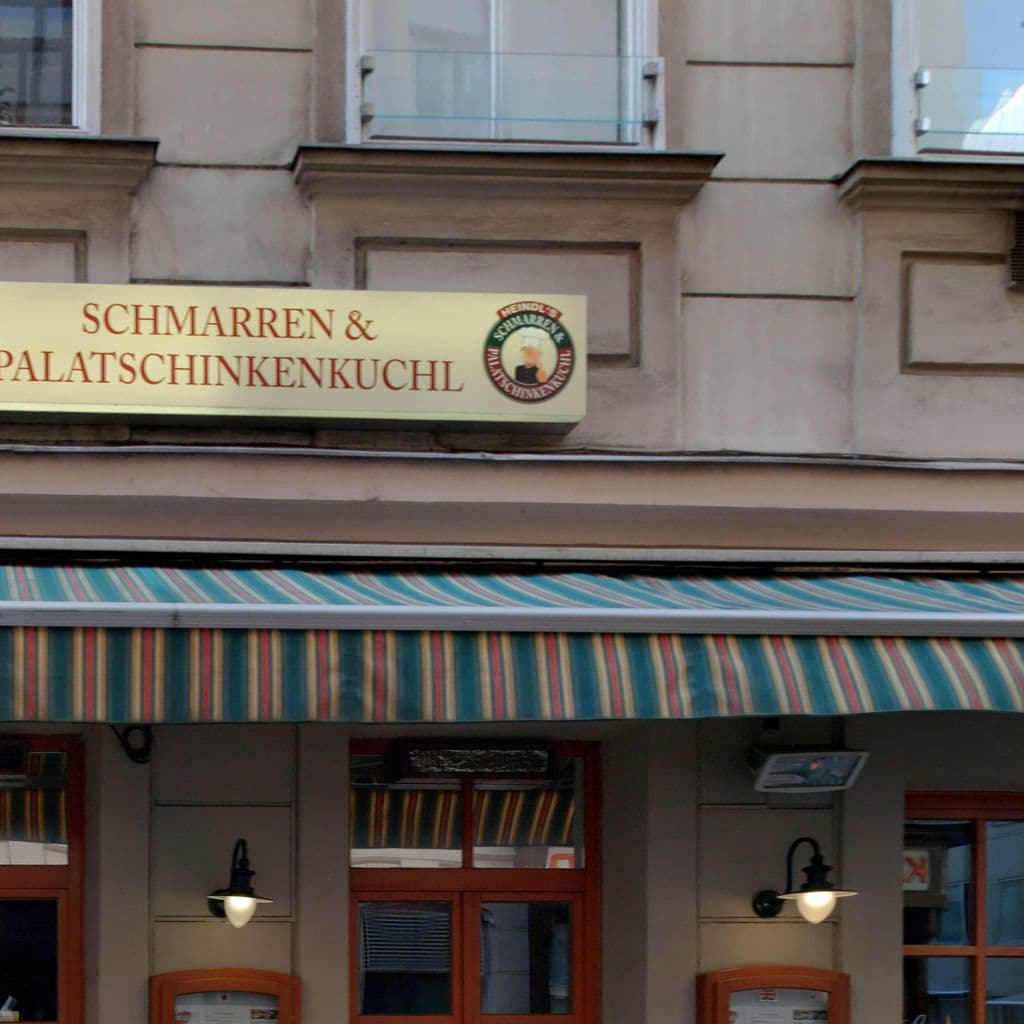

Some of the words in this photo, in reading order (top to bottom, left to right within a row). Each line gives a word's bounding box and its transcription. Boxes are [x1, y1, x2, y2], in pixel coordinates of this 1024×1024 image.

[81, 302, 335, 341] SCHMARREN
[343, 310, 378, 341] &
[501, 302, 559, 318] HEINDL'S
[494, 314, 560, 341] SCHMARREN
[554, 332, 566, 343] &
[487, 348, 572, 399] PALATSCHINKENKUCHL
